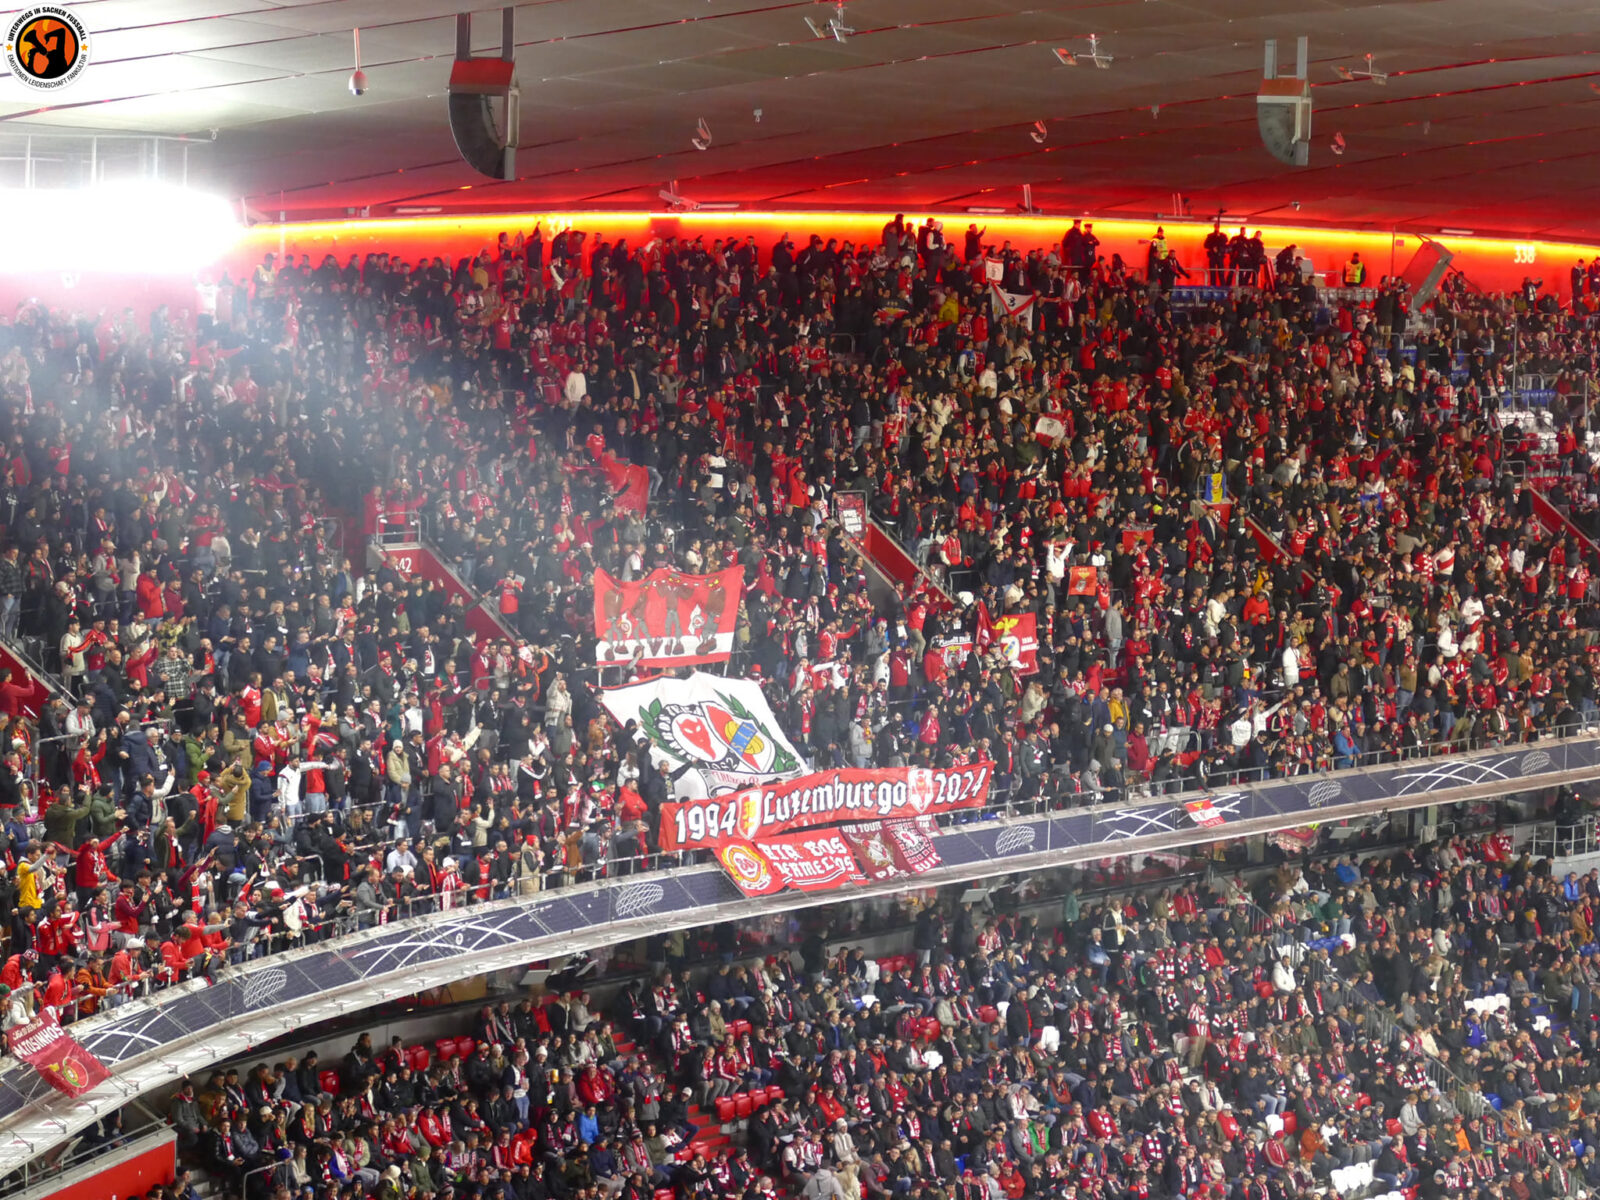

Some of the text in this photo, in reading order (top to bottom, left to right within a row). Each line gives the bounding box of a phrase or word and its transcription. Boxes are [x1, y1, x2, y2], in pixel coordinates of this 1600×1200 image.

[1514, 245, 1536, 264] 338
[396, 557, 412, 573] 42
[675, 801, 736, 843] 1994
[762, 772, 908, 826] Luxemburgo
[934, 766, 988, 804] 2024
[858, 821, 882, 833] TOUR
